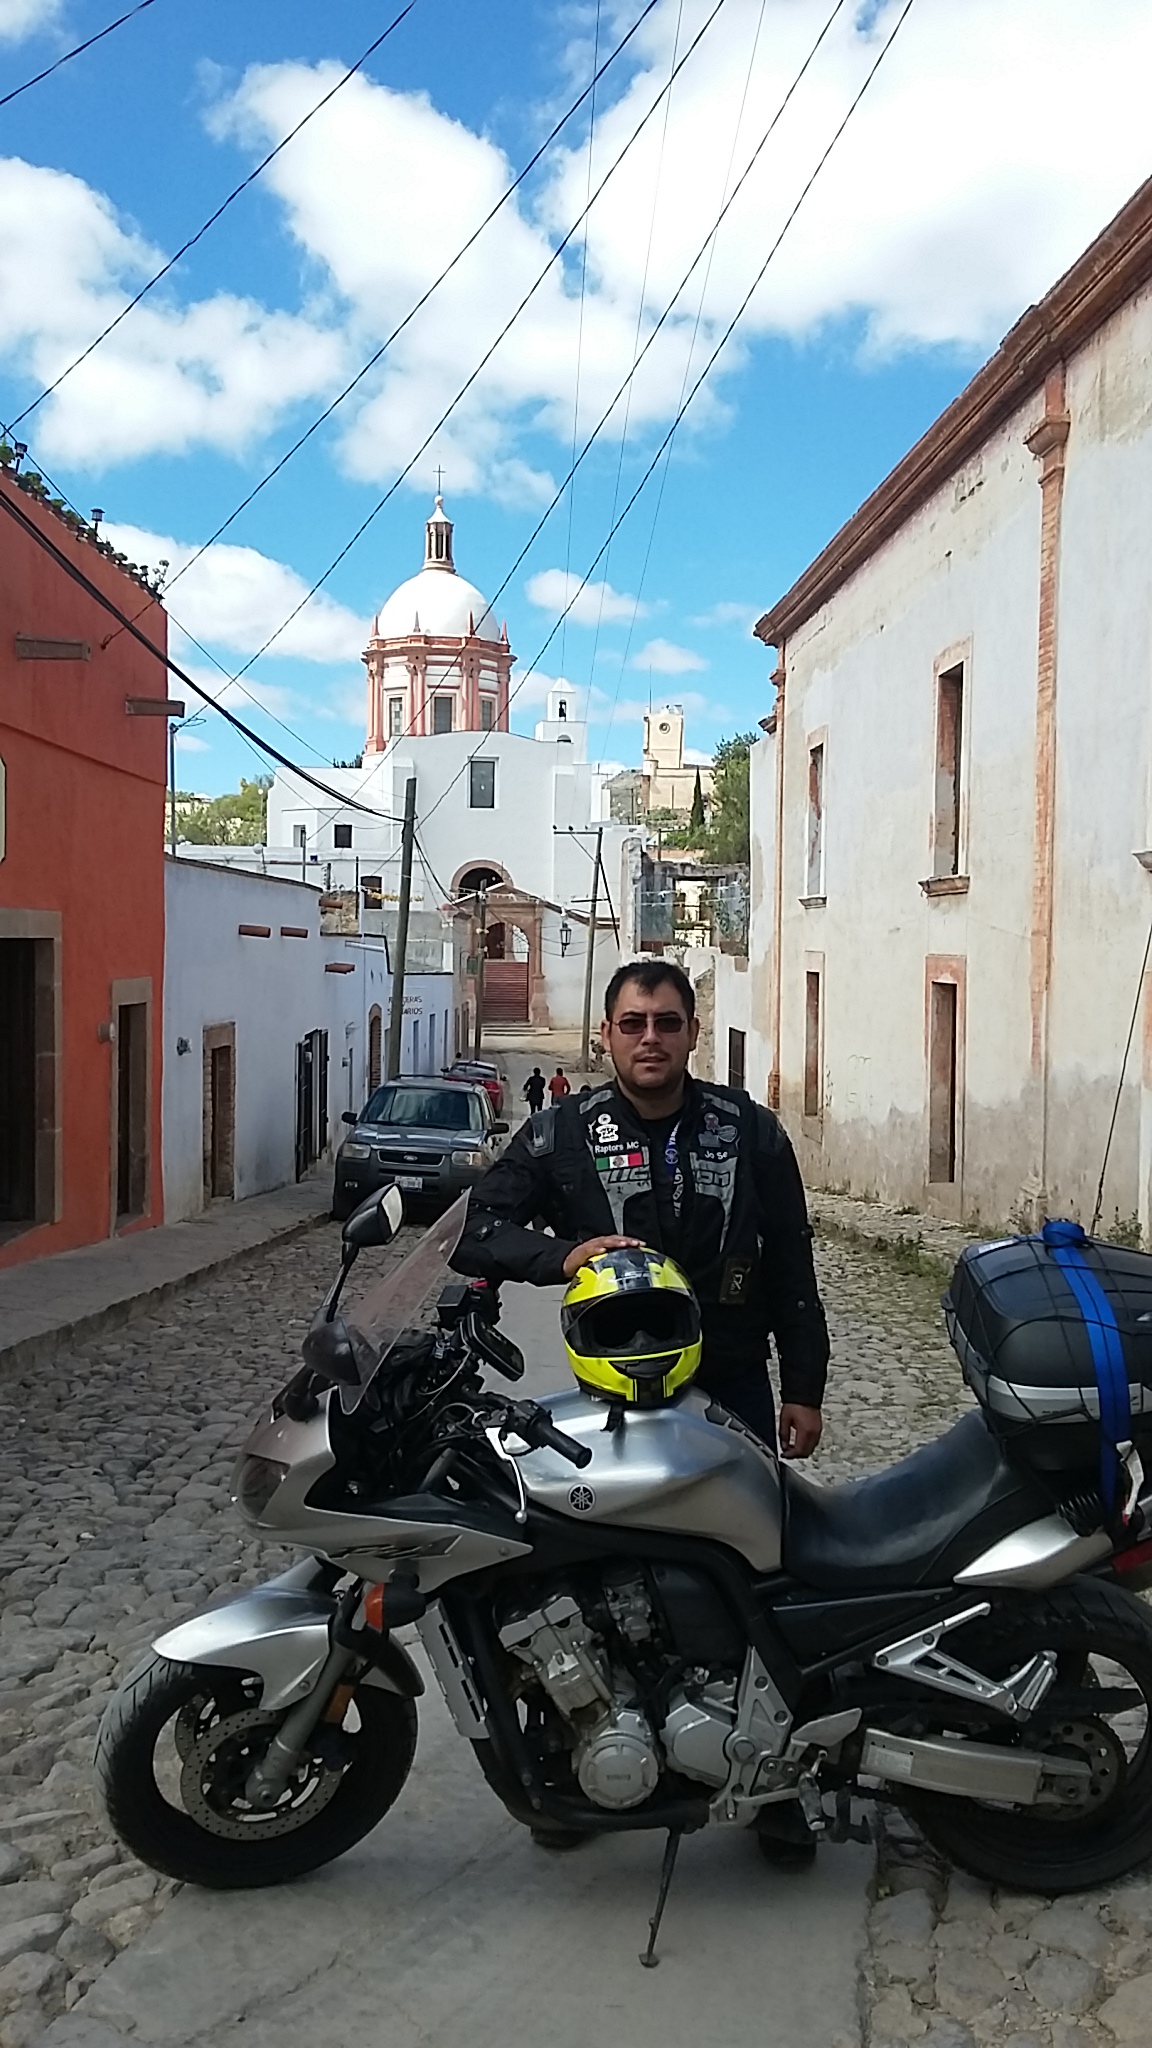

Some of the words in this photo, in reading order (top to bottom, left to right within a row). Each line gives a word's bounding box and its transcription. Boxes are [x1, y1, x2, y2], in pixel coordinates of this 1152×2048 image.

[387, 1007, 423, 1015] SARIOS
[594, 1145, 624, 1154] Raptors
[626, 1141, 640, 1150] MC
